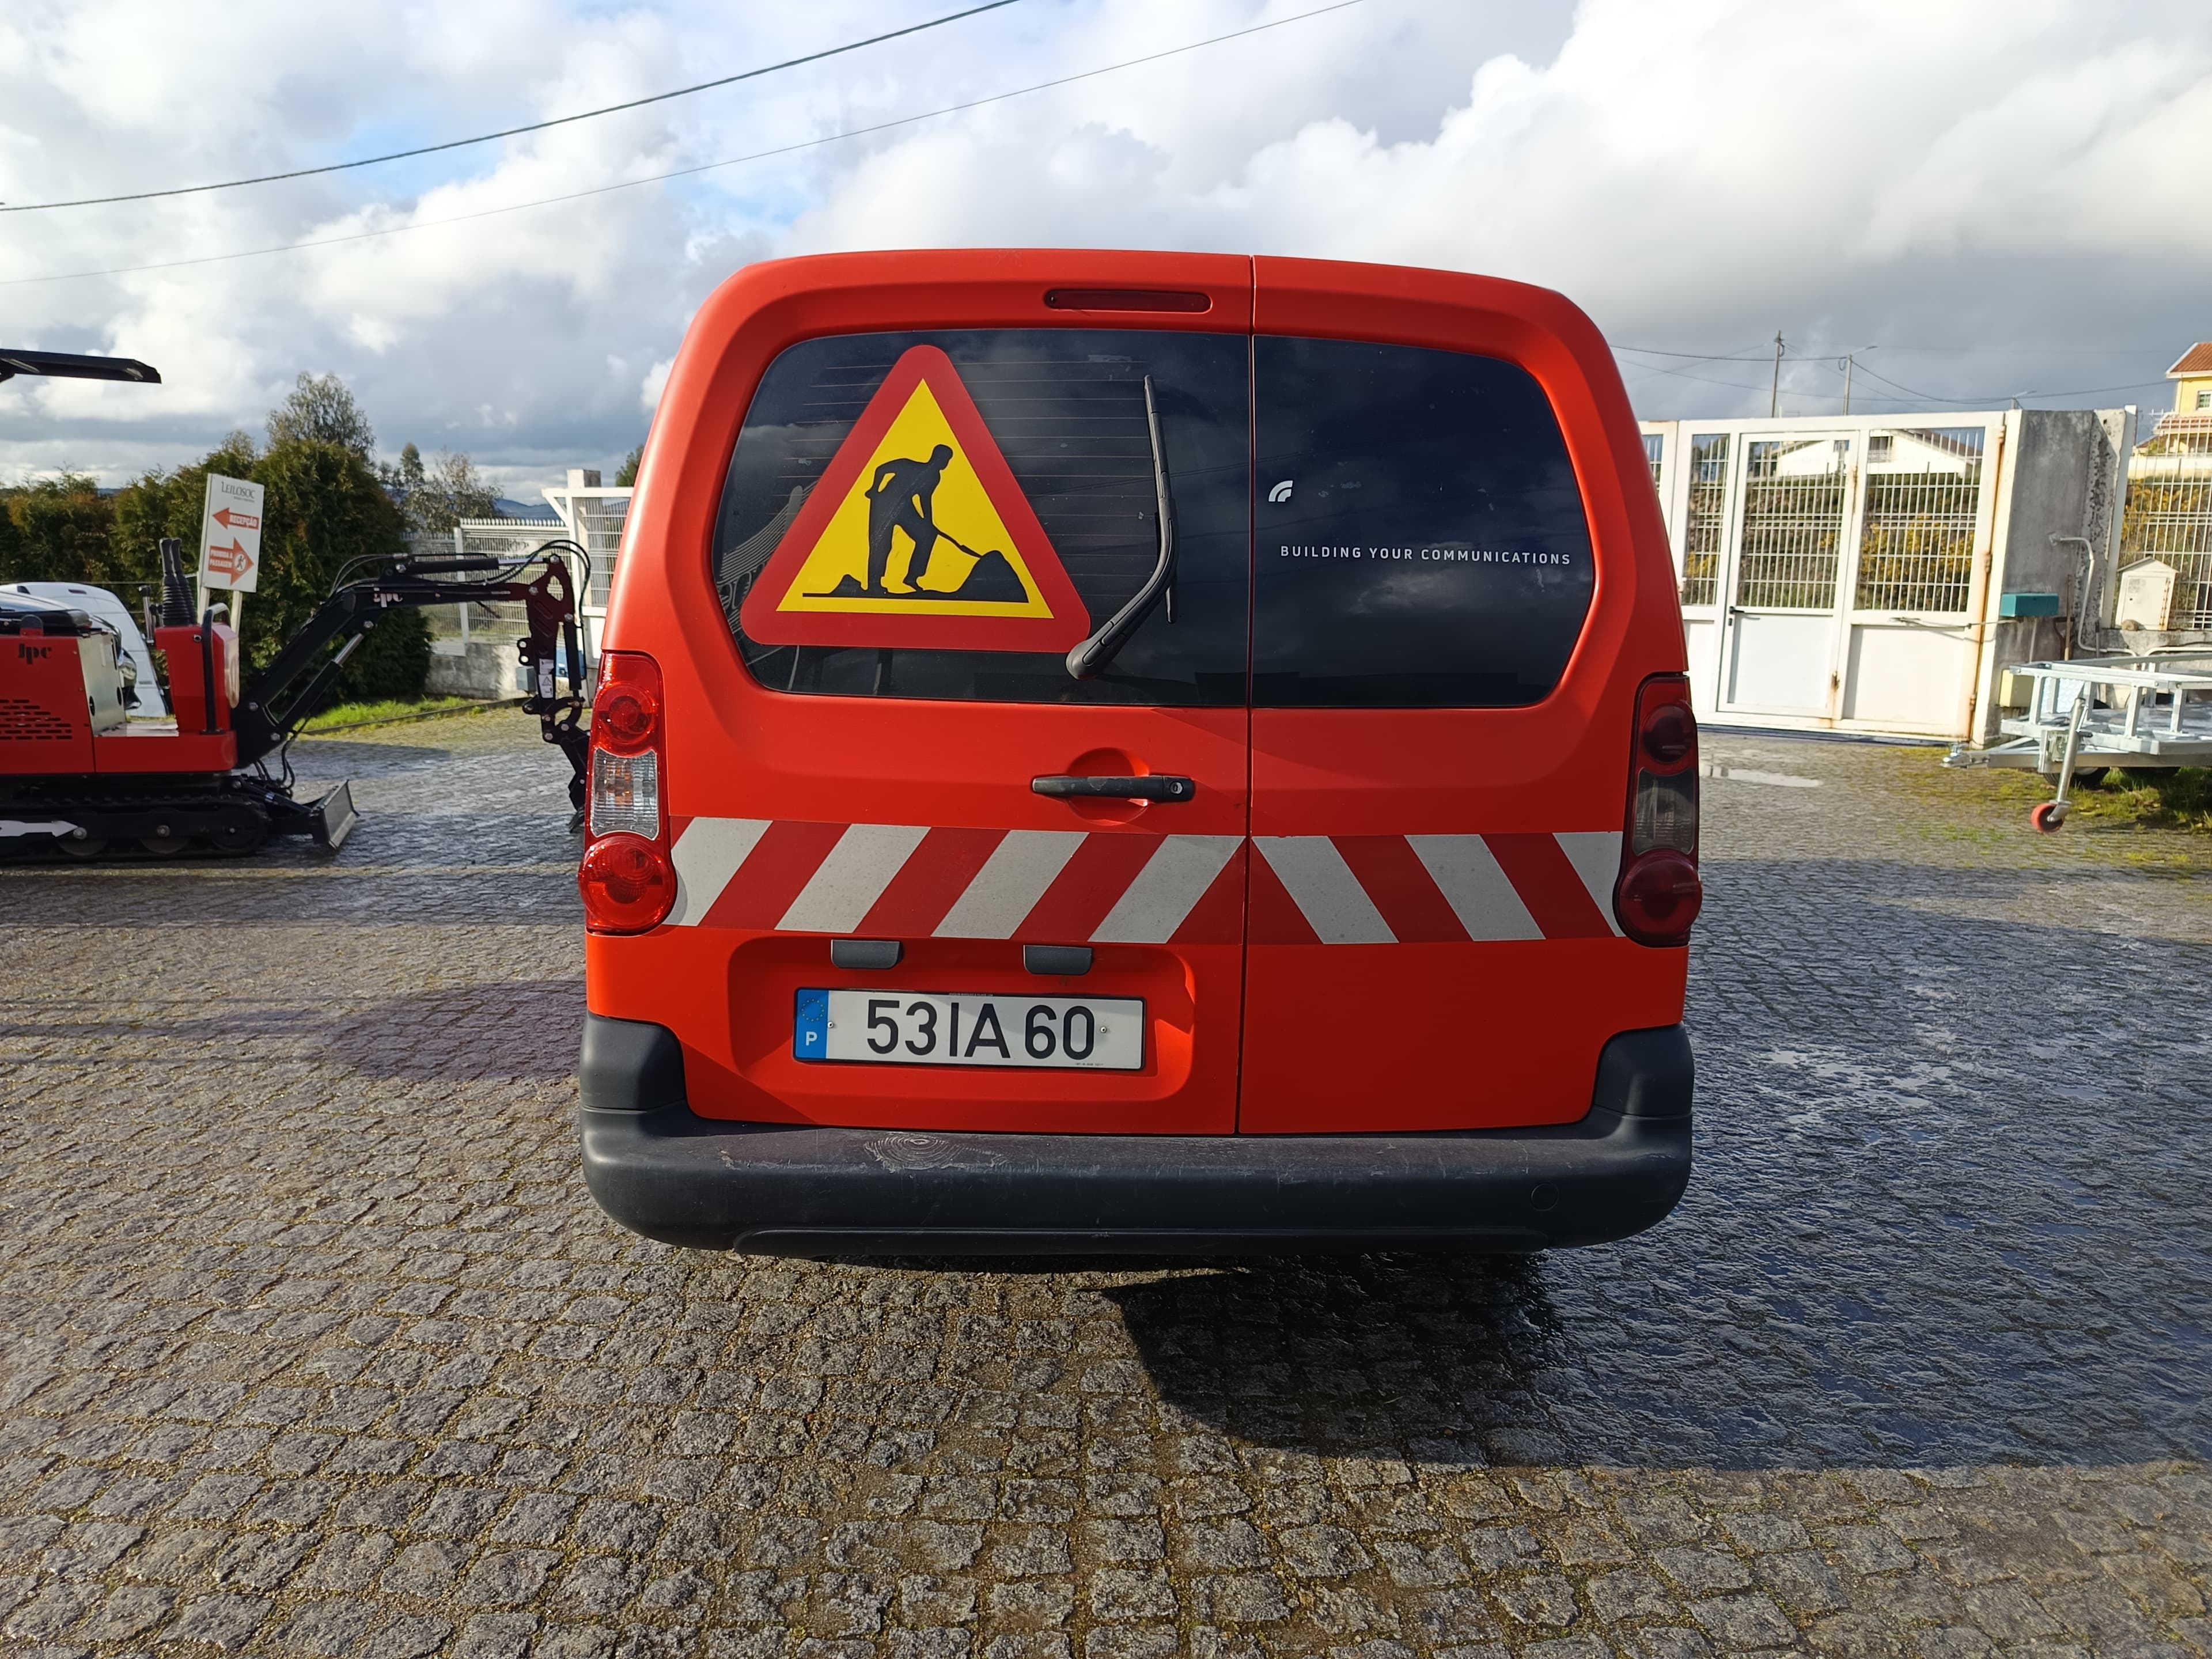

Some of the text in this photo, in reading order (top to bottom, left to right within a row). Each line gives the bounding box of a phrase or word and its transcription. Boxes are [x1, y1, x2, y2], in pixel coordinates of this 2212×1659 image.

[1281, 546, 1570, 565] BUILDING YOUR COMMUNICATIONS
[805, 1031, 818, 1046] P
[867, 999, 937, 1056] 53
[1025, 1005, 1094, 1060] 60
